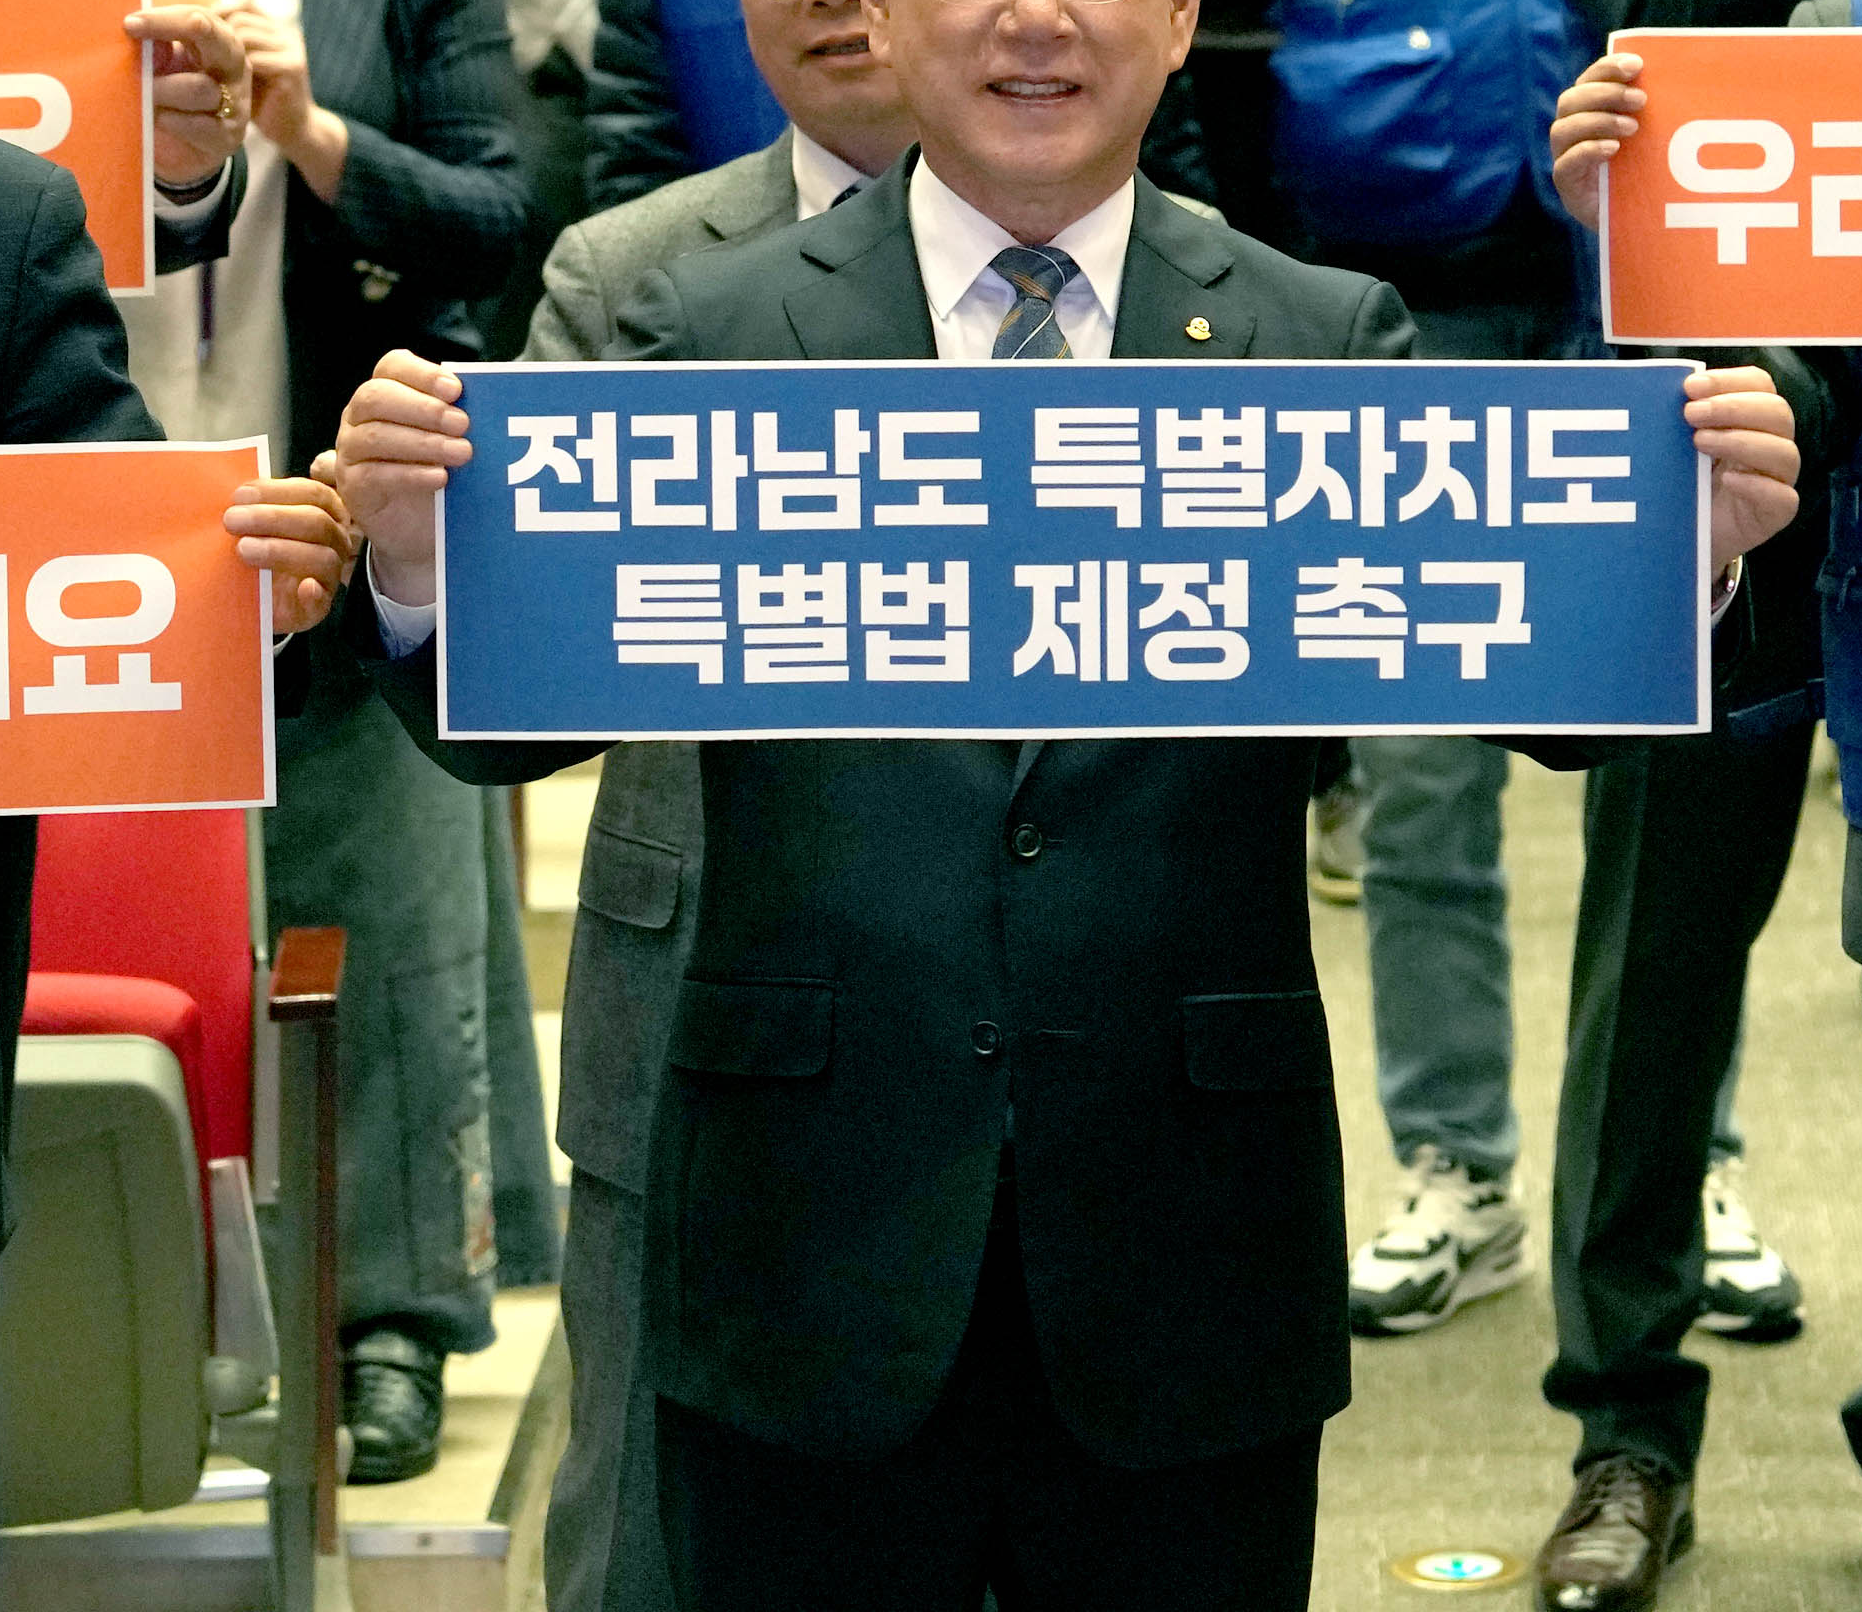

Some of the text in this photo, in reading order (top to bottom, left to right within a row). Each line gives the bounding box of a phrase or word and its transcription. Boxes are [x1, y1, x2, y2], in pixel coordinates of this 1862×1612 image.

[507, 405, 1637, 533] 전라남도 특별자치도
[612, 557, 1532, 685] 특별법 제정 촉구
